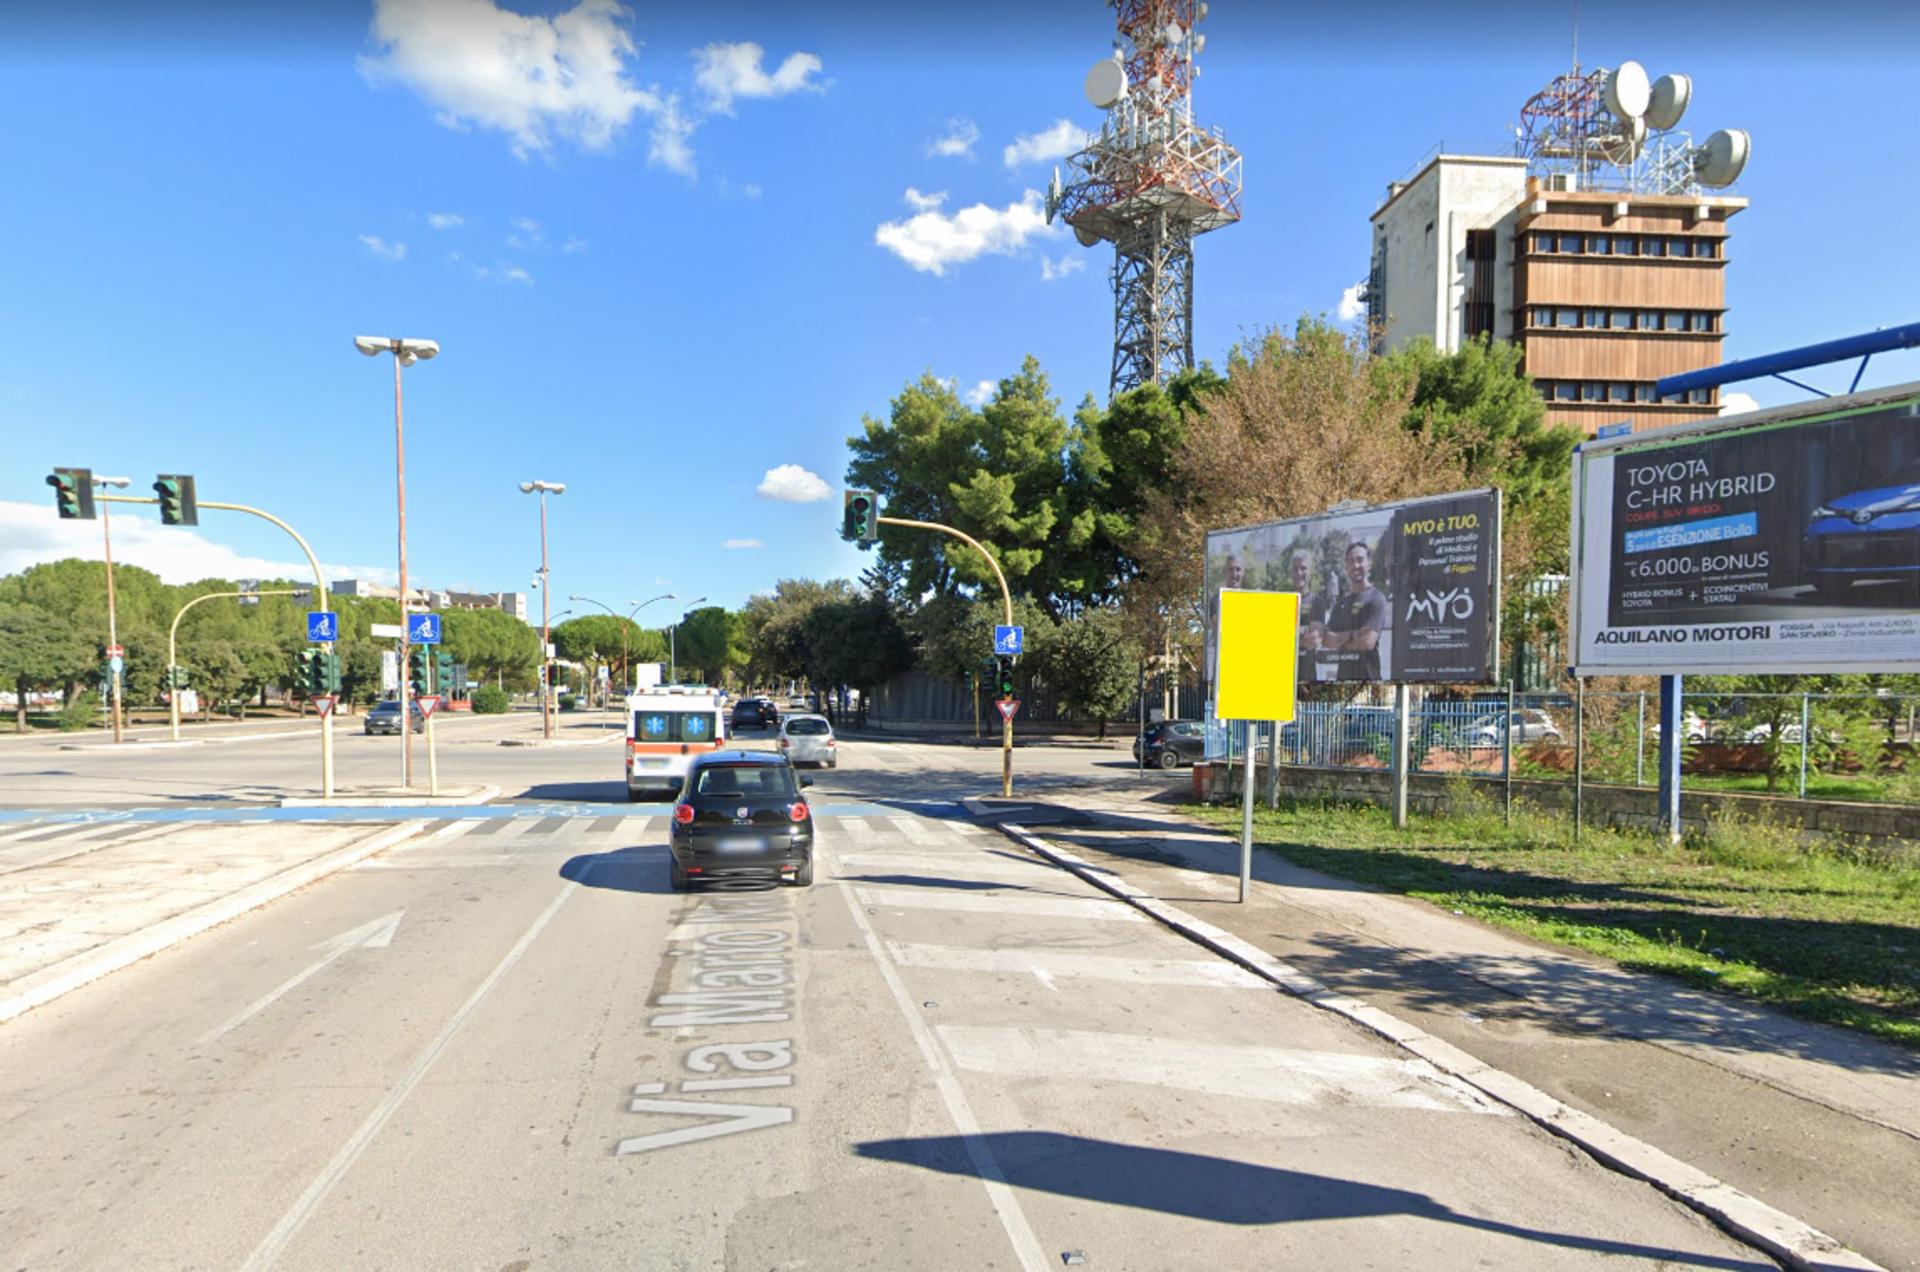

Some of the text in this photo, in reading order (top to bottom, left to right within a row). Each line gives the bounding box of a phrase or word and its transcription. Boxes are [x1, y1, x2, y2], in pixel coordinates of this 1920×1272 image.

[1627, 458, 1709, 487] TOYOTA
[1626, 471, 1776, 509] C-HR HYBRID
[1403, 519, 1436, 537] MYO
[1447, 513, 1480, 531] TUO.
[1657, 527, 1722, 548] ESENZIONE
[1723, 523, 1753, 538] Bollo
[1639, 557, 1692, 576] 6.000
[1701, 551, 1769, 573] BONUS
[1653, 588, 1683, 598] BONUS
[1594, 625, 1771, 644] AQUILANO MOTORI
